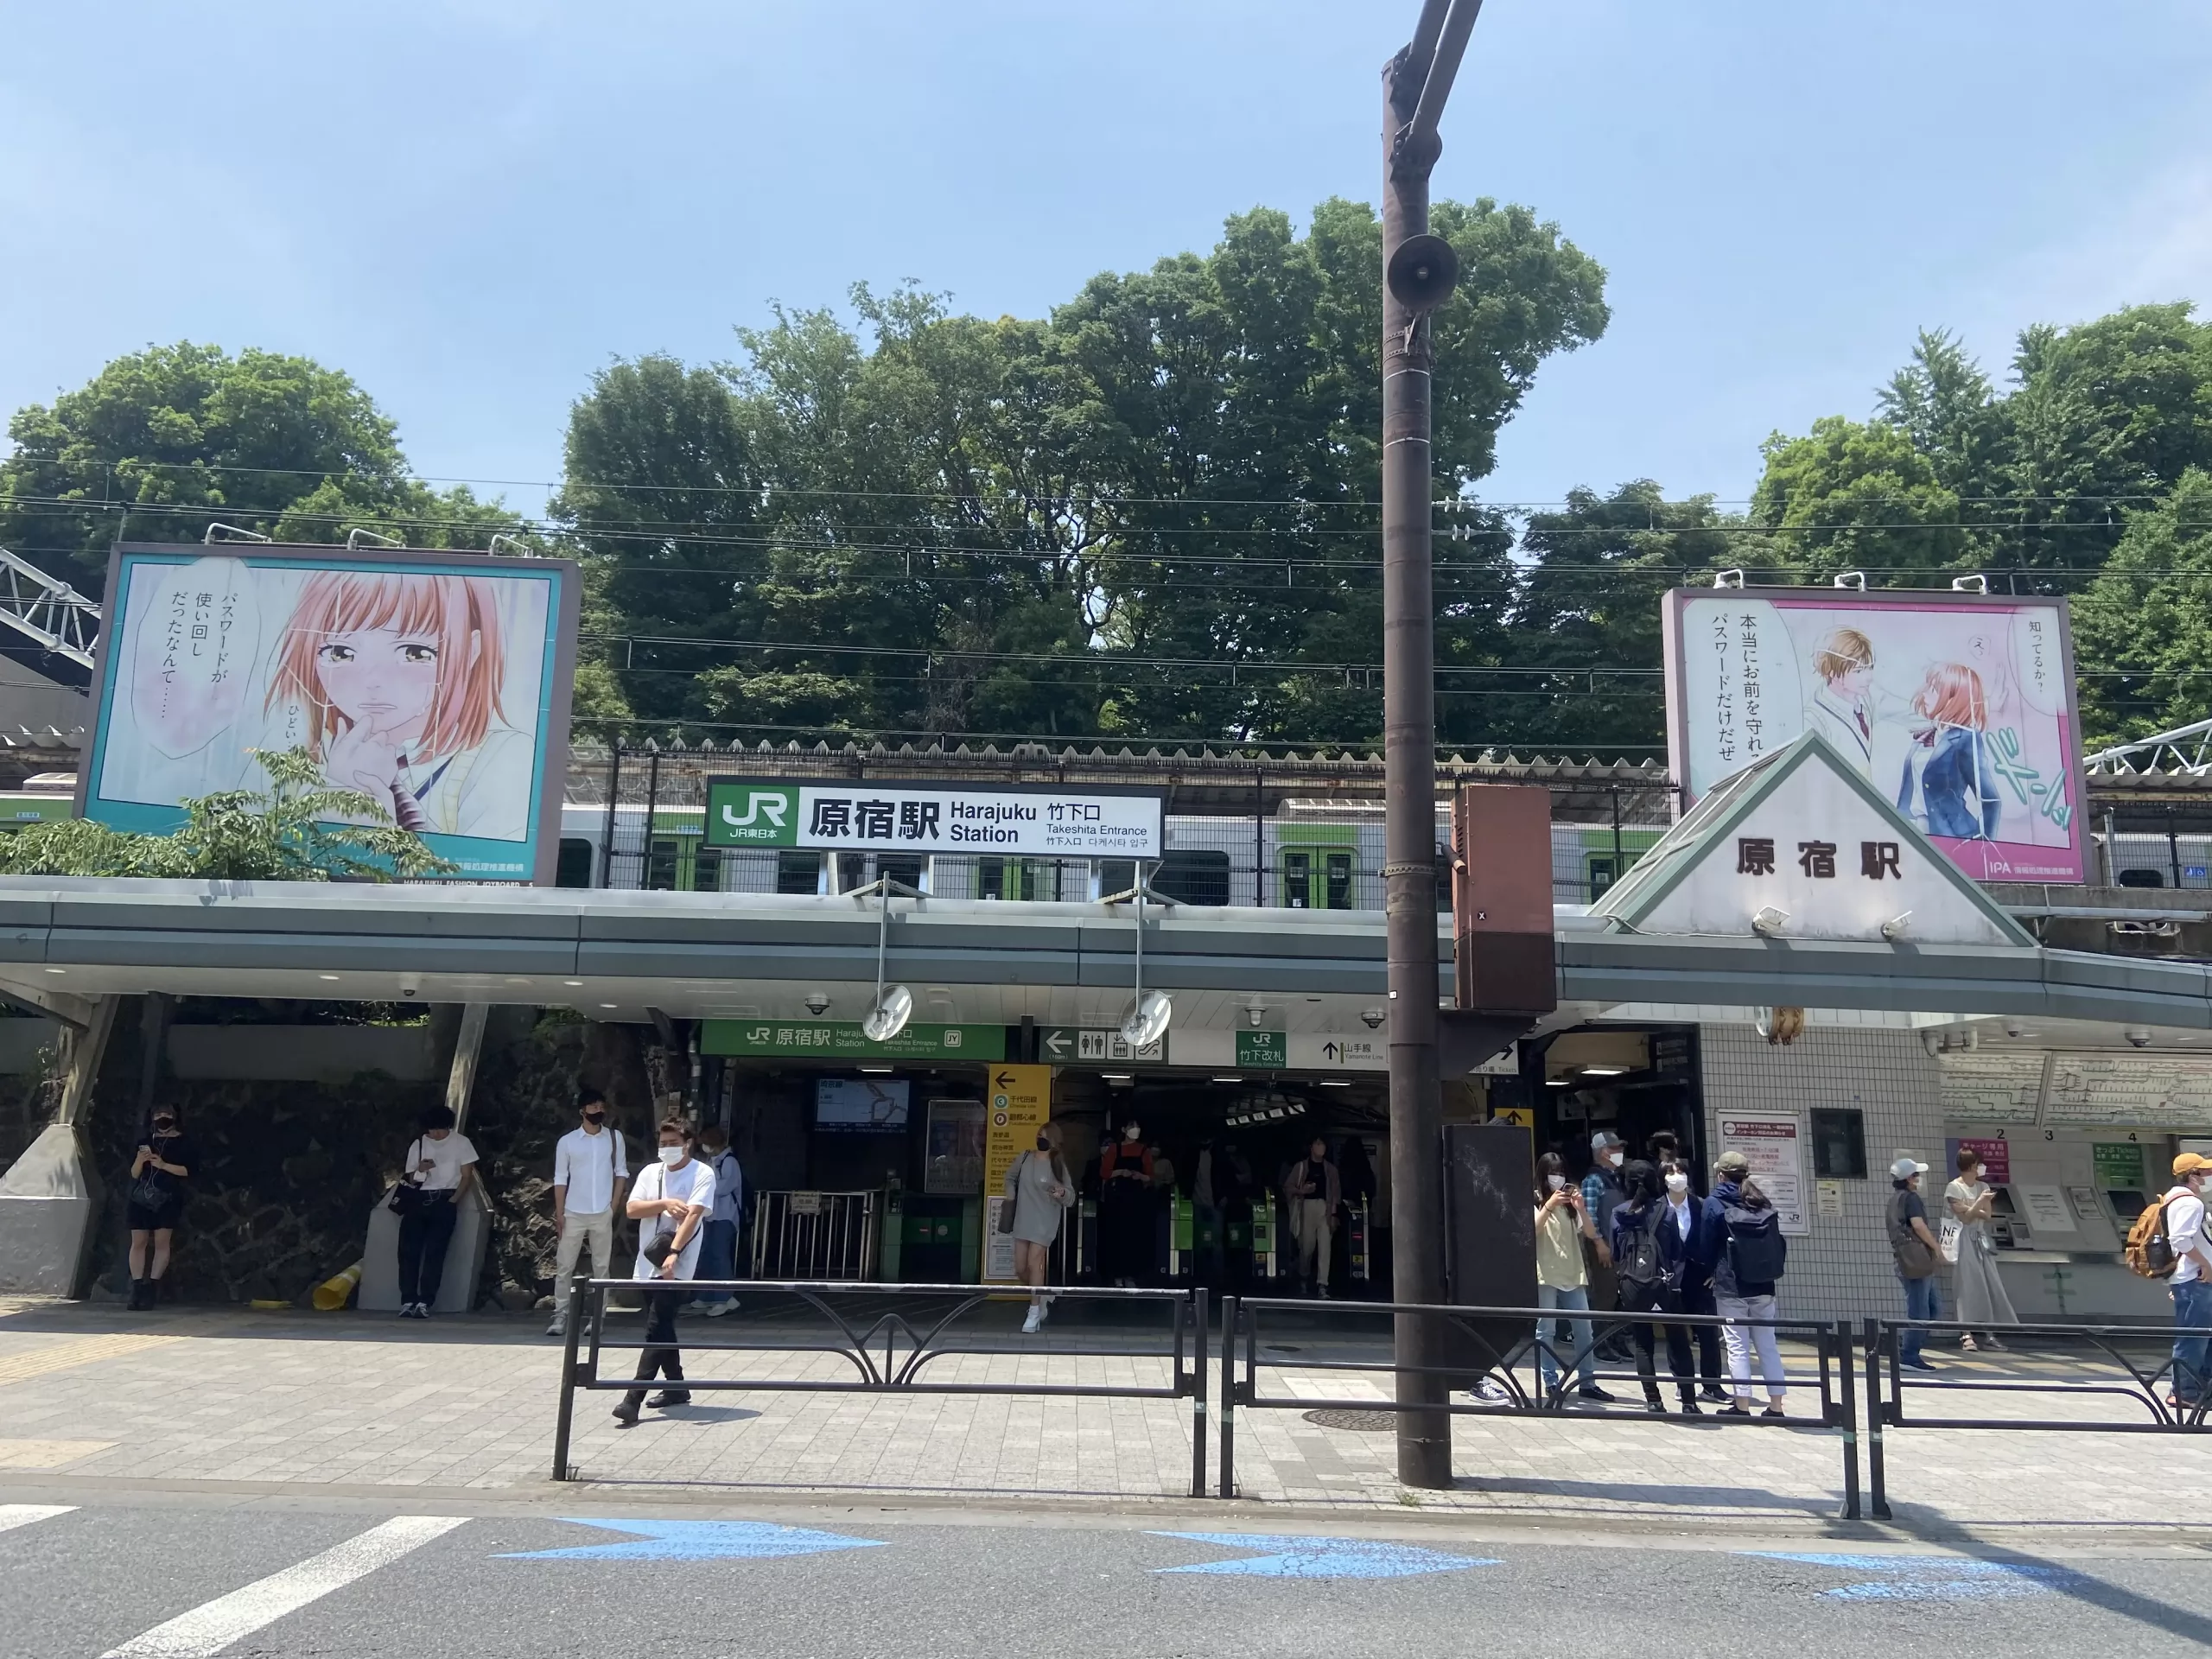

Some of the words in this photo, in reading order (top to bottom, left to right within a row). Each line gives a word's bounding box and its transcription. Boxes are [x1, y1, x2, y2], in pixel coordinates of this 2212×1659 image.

[191, 592, 213, 657] 使い回し
[211, 592, 238, 683] パスワードが
[2028, 620, 2046, 693] 知ってるか？
[1712, 613, 1735, 761] パスワードだけだぜ
[722, 791, 788, 827] JR
[950, 801, 1037, 823] Harajuku
[1046, 802, 1101, 821] 竹下口
[809, 798, 940, 841] 原宿駅
[729, 828, 778, 839] JR東日本
[950, 823, 1019, 843] Station
[1046, 823, 1096, 835] Takeshita
[1100, 824, 1147, 836] Entrance
[1046, 836, 1082, 846] 竹下入口
[1088, 837, 1127, 848] 다케시타
[1129, 838, 1148, 849] 입구
[1736, 837, 1902, 880] 原宿駅
[1989, 861, 2012, 874] IPA
[746, 1027, 771, 1041] JR
[775, 1027, 831, 1046] 原宿駅
[836, 1028, 865, 1039] Haraju
[1253, 1033, 1271, 1044] JR
[836, 1039, 865, 1047] Station
[1344, 1043, 1371, 1053] 山手線
[1239, 1049, 1284, 1062] 竹下改札
[1009, 1095, 1038, 1103] 千代田線
[1996, 1128, 2005, 1140] 2
[2044, 1129, 2054, 1141] 3
[2128, 1132, 2138, 1142] 4
